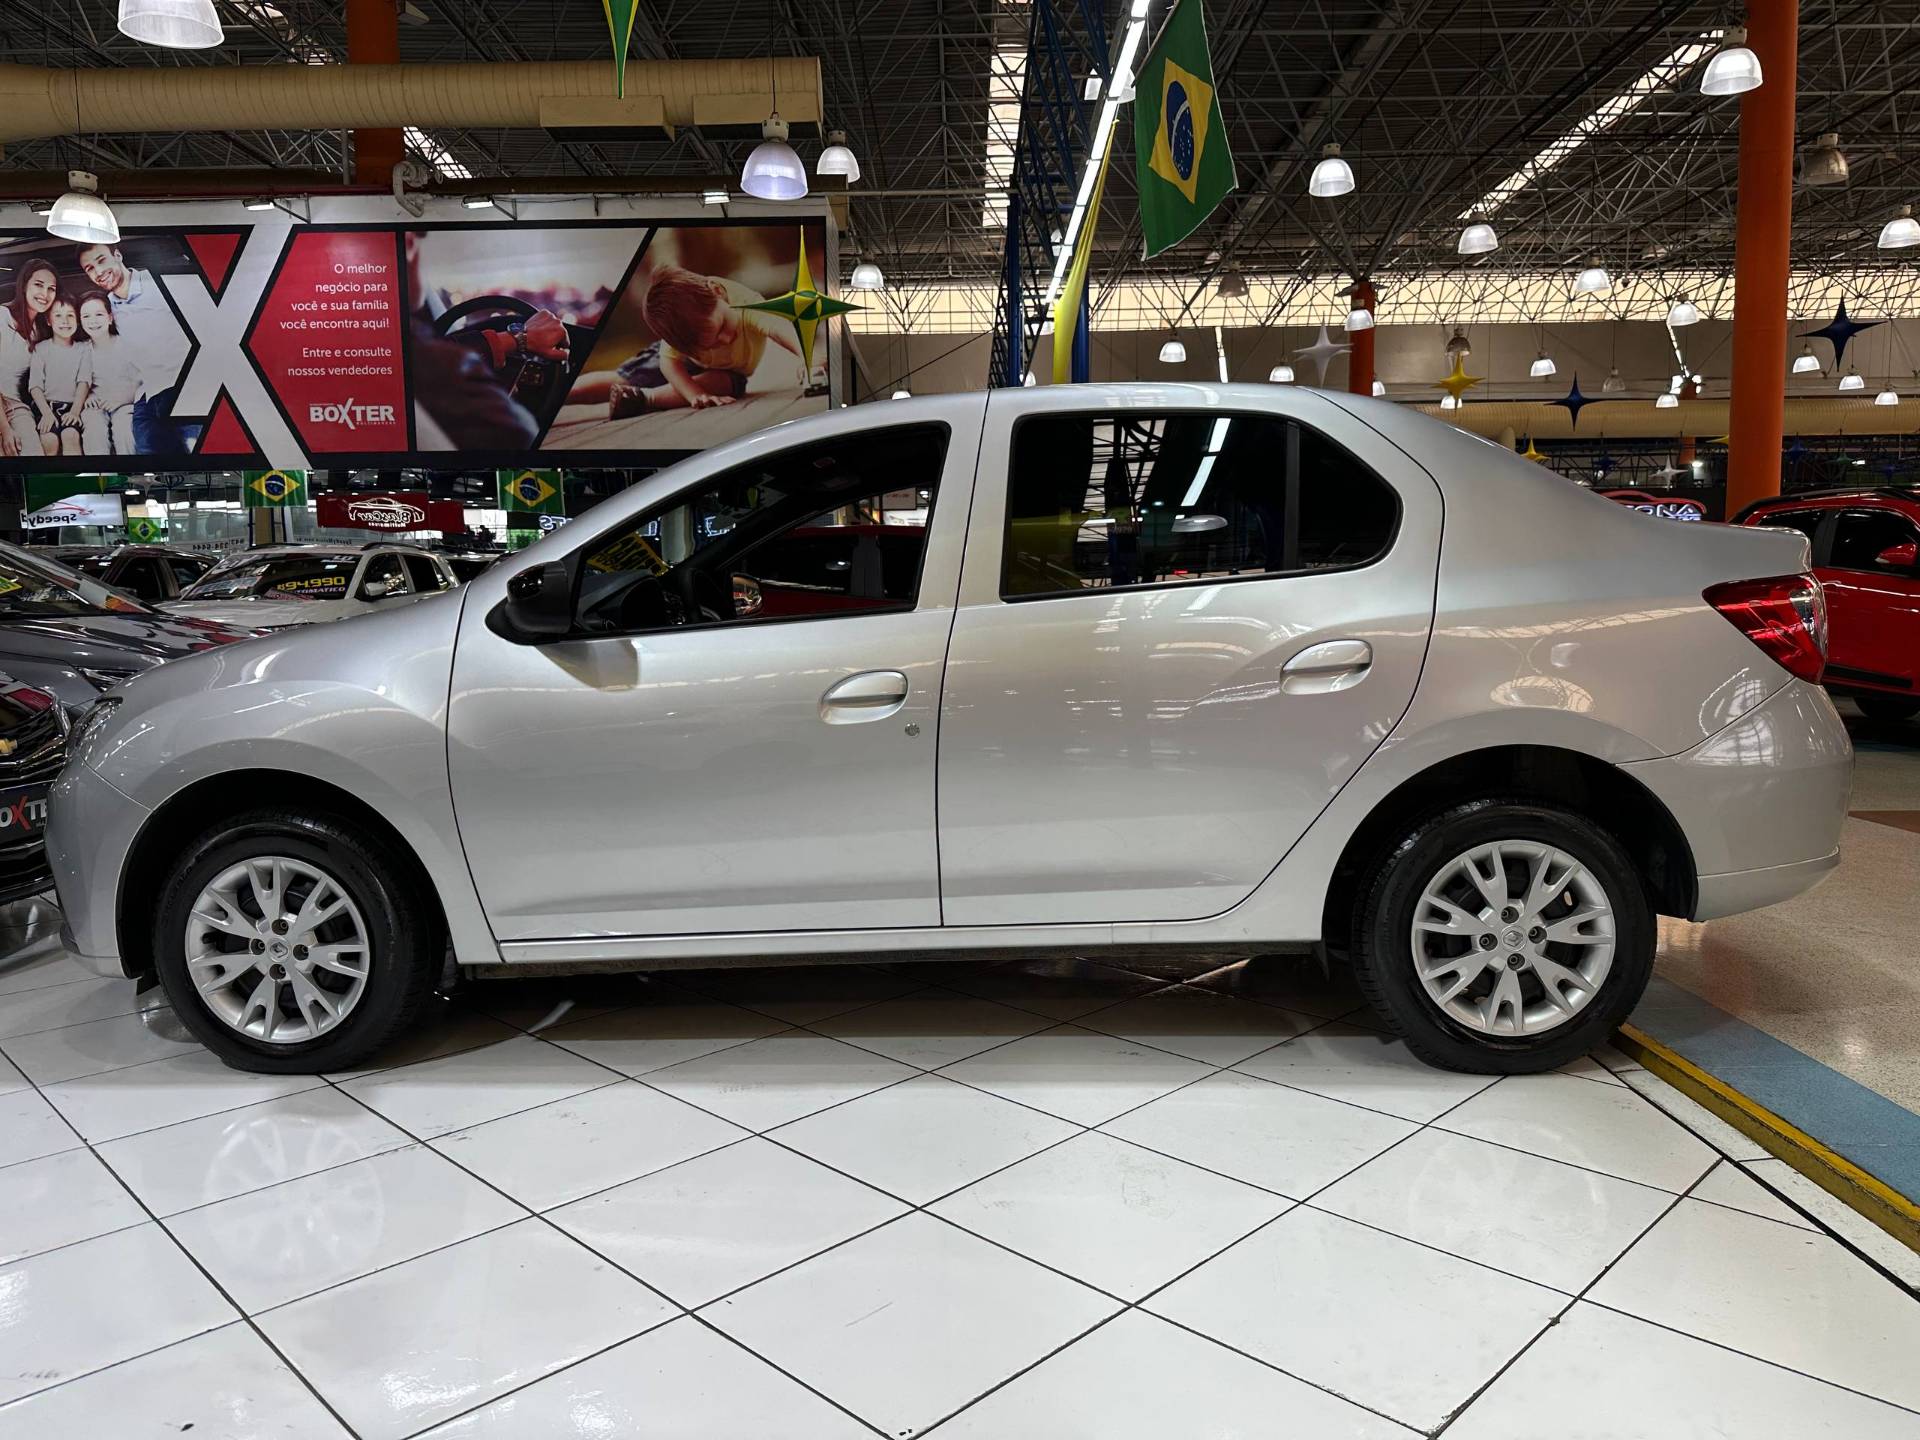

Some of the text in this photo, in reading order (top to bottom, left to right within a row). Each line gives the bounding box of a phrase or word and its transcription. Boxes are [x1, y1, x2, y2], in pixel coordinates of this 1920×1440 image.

[334, 263, 387, 274] O melhor
[315, 282, 388, 294] negócio para
[291, 300, 389, 311] você e sua família
[280, 318, 390, 330] você encontra aqui!
[302, 347, 392, 358] Entre e consulte
[287, 365, 393, 377] nossos vendedores
[309, 398, 395, 430] BOXTER
